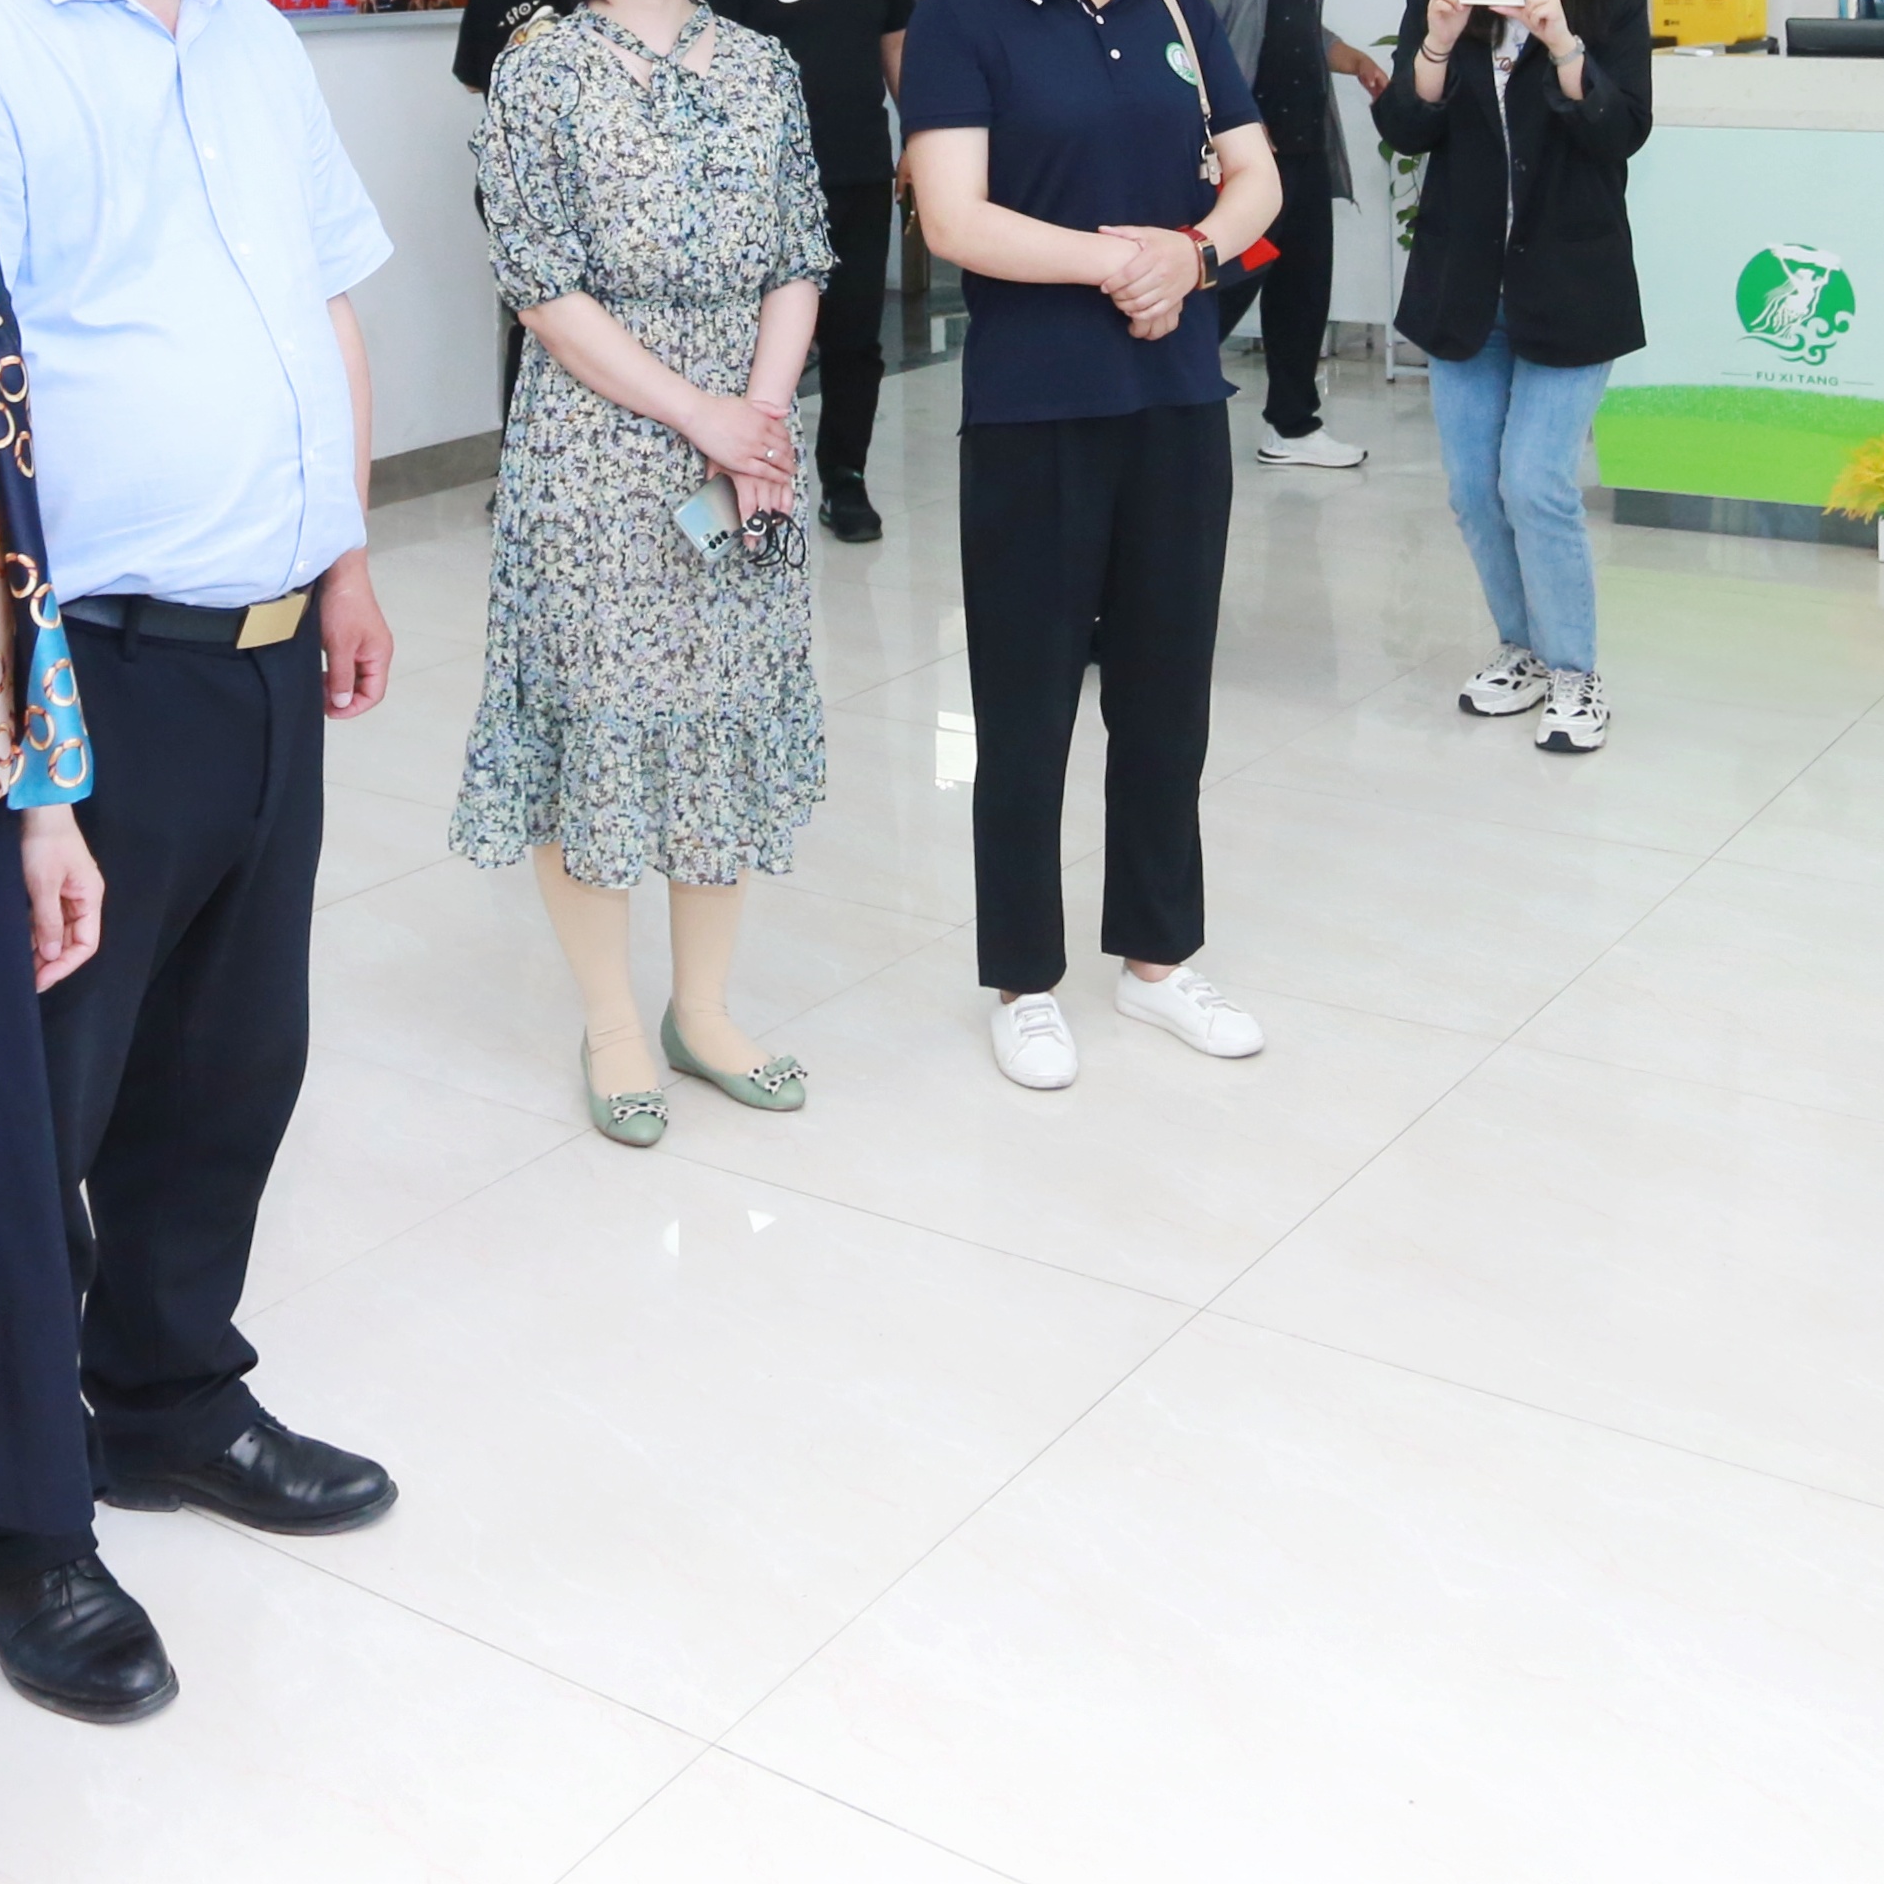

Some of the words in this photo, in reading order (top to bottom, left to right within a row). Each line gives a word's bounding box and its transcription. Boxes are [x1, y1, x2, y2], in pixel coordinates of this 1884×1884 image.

[1756, 371, 1775, 382] FU
[1779, 373, 1793, 383] XI
[1797, 374, 1839, 387] TANG
